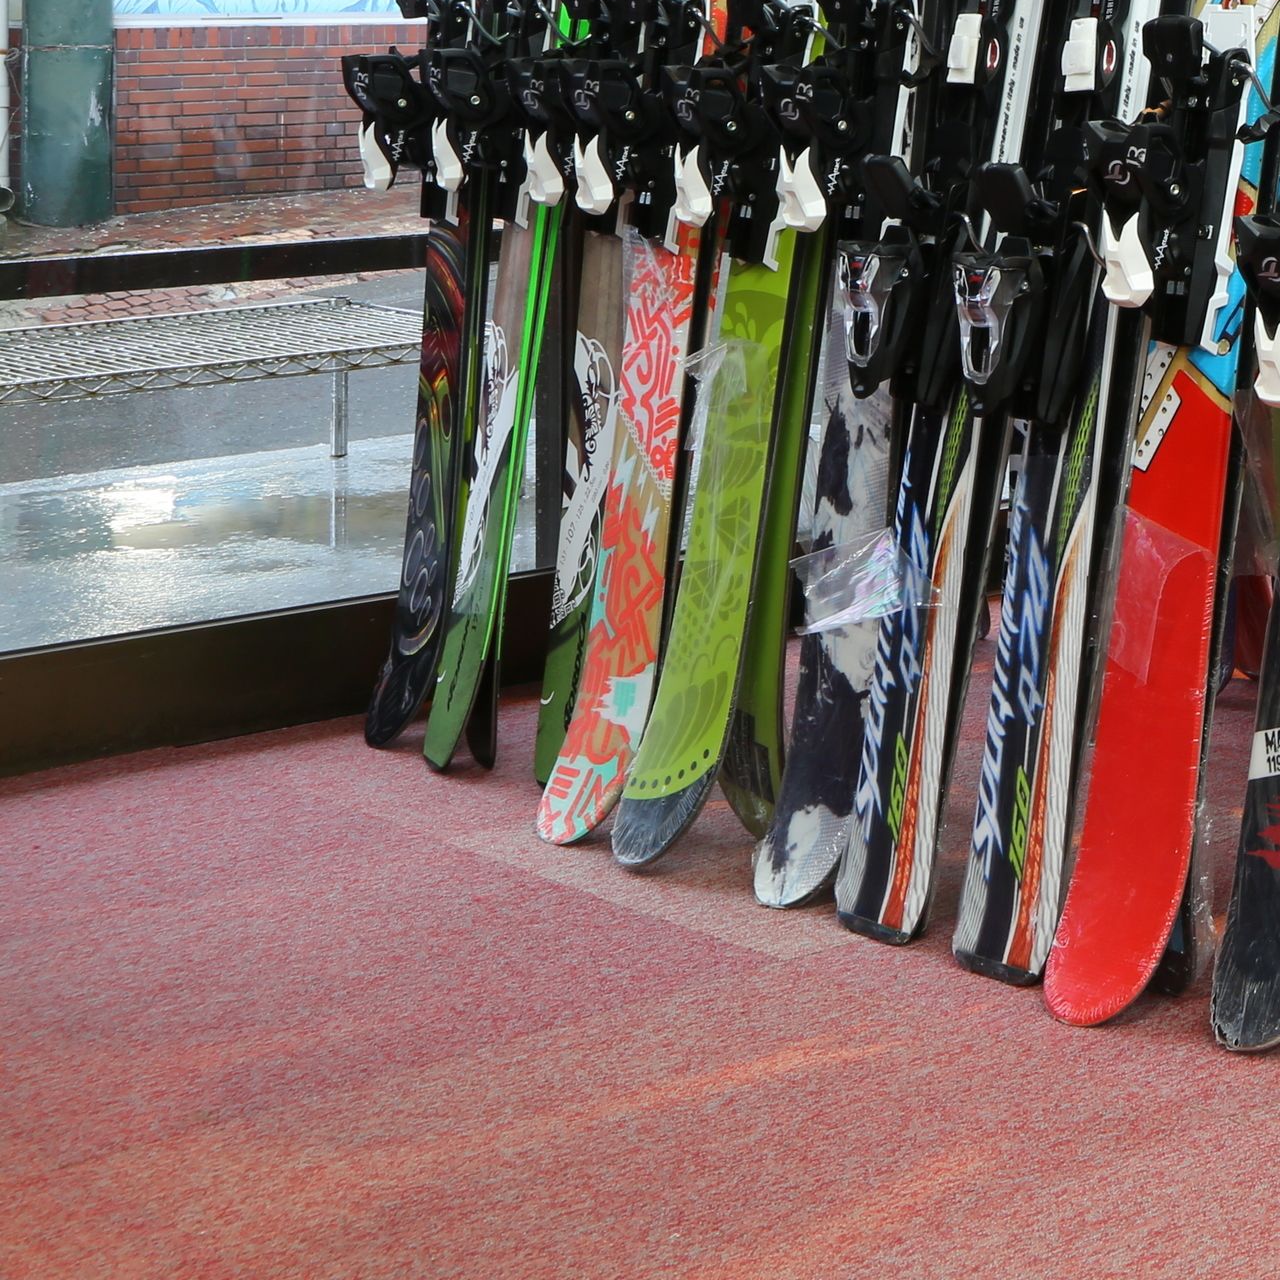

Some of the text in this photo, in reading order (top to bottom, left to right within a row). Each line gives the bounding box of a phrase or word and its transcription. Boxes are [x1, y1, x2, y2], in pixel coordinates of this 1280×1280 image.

[1012, 42, 1021, 67] made
[1128, 50, 1137, 76] made
[1124, 84, 1133, 107] italy
[888, 733, 908, 842] 160
[1009, 765, 1030, 883] 160
